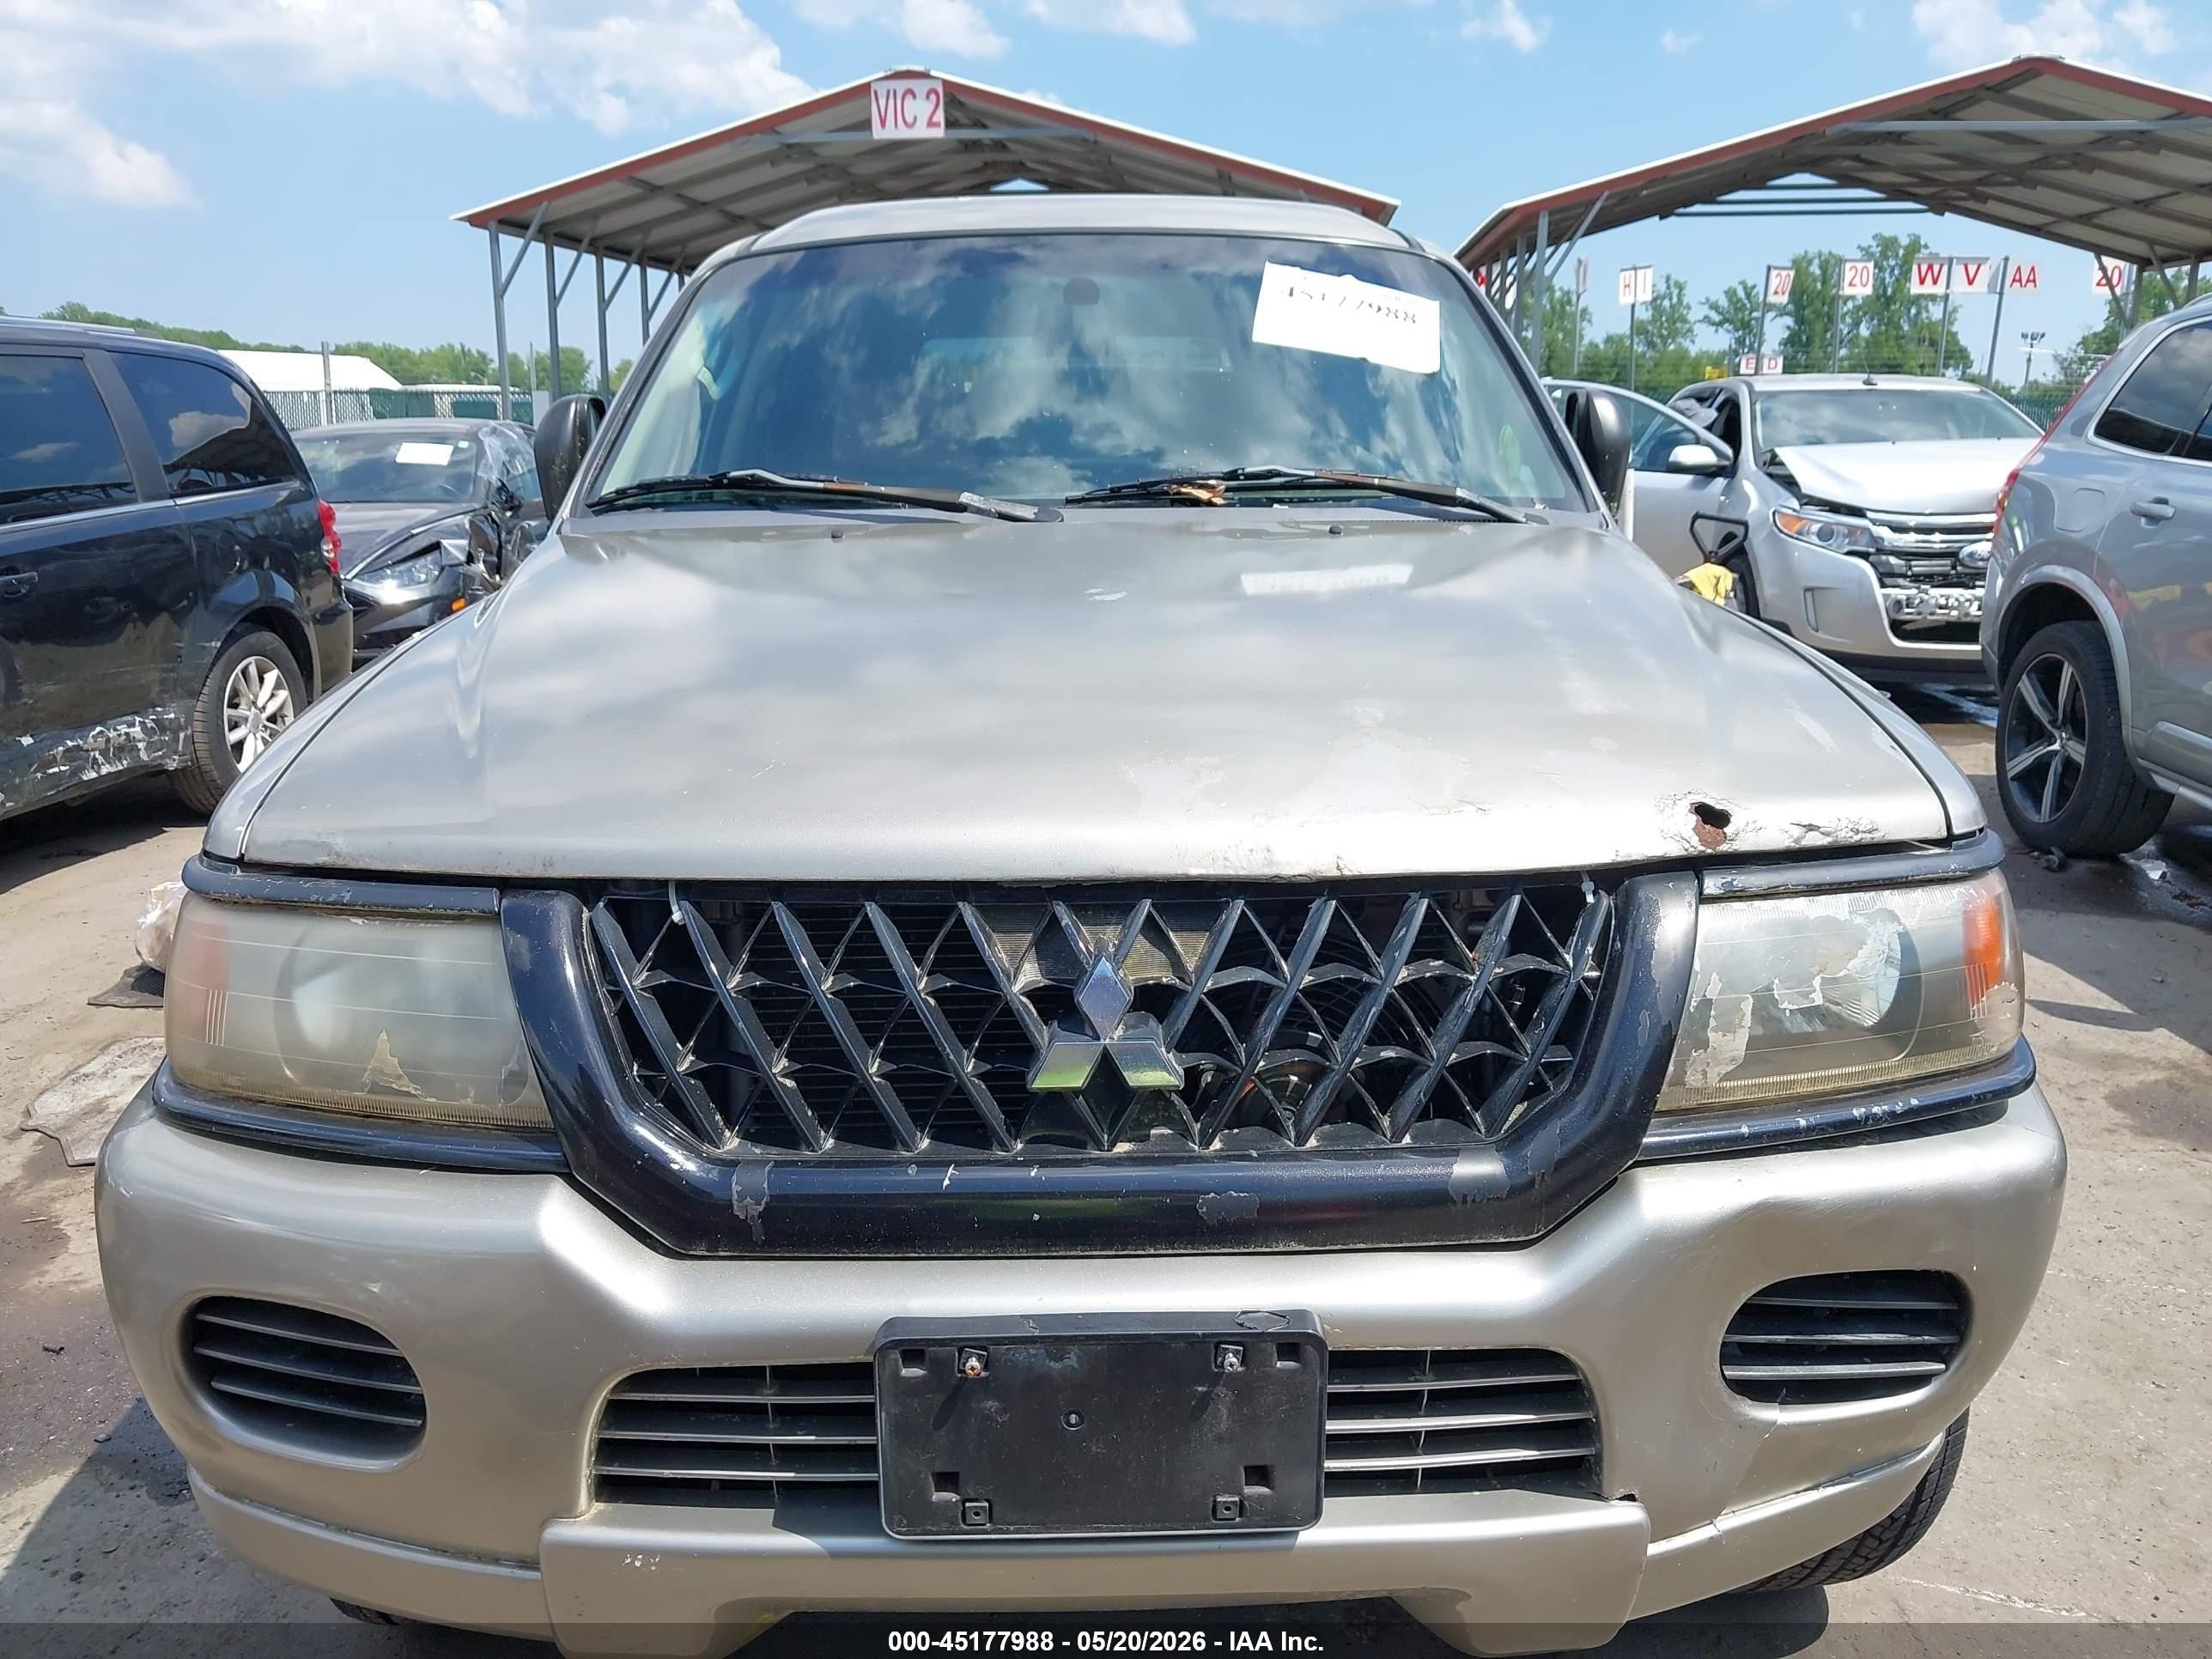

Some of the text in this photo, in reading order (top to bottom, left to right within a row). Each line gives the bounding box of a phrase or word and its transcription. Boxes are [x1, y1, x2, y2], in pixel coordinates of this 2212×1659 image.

[873, 88, 941, 130] VIC 2
[1623, 274, 1632, 297] H
[1773, 271, 1791, 295] 20
[1848, 264, 1870, 288] 20
[1917, 263, 1944, 286] W
[1964, 263, 1982, 286] V
[2009, 265, 2038, 289] AA
[1745, 356, 1755, 370] E
[1767, 356, 1778, 370] D
